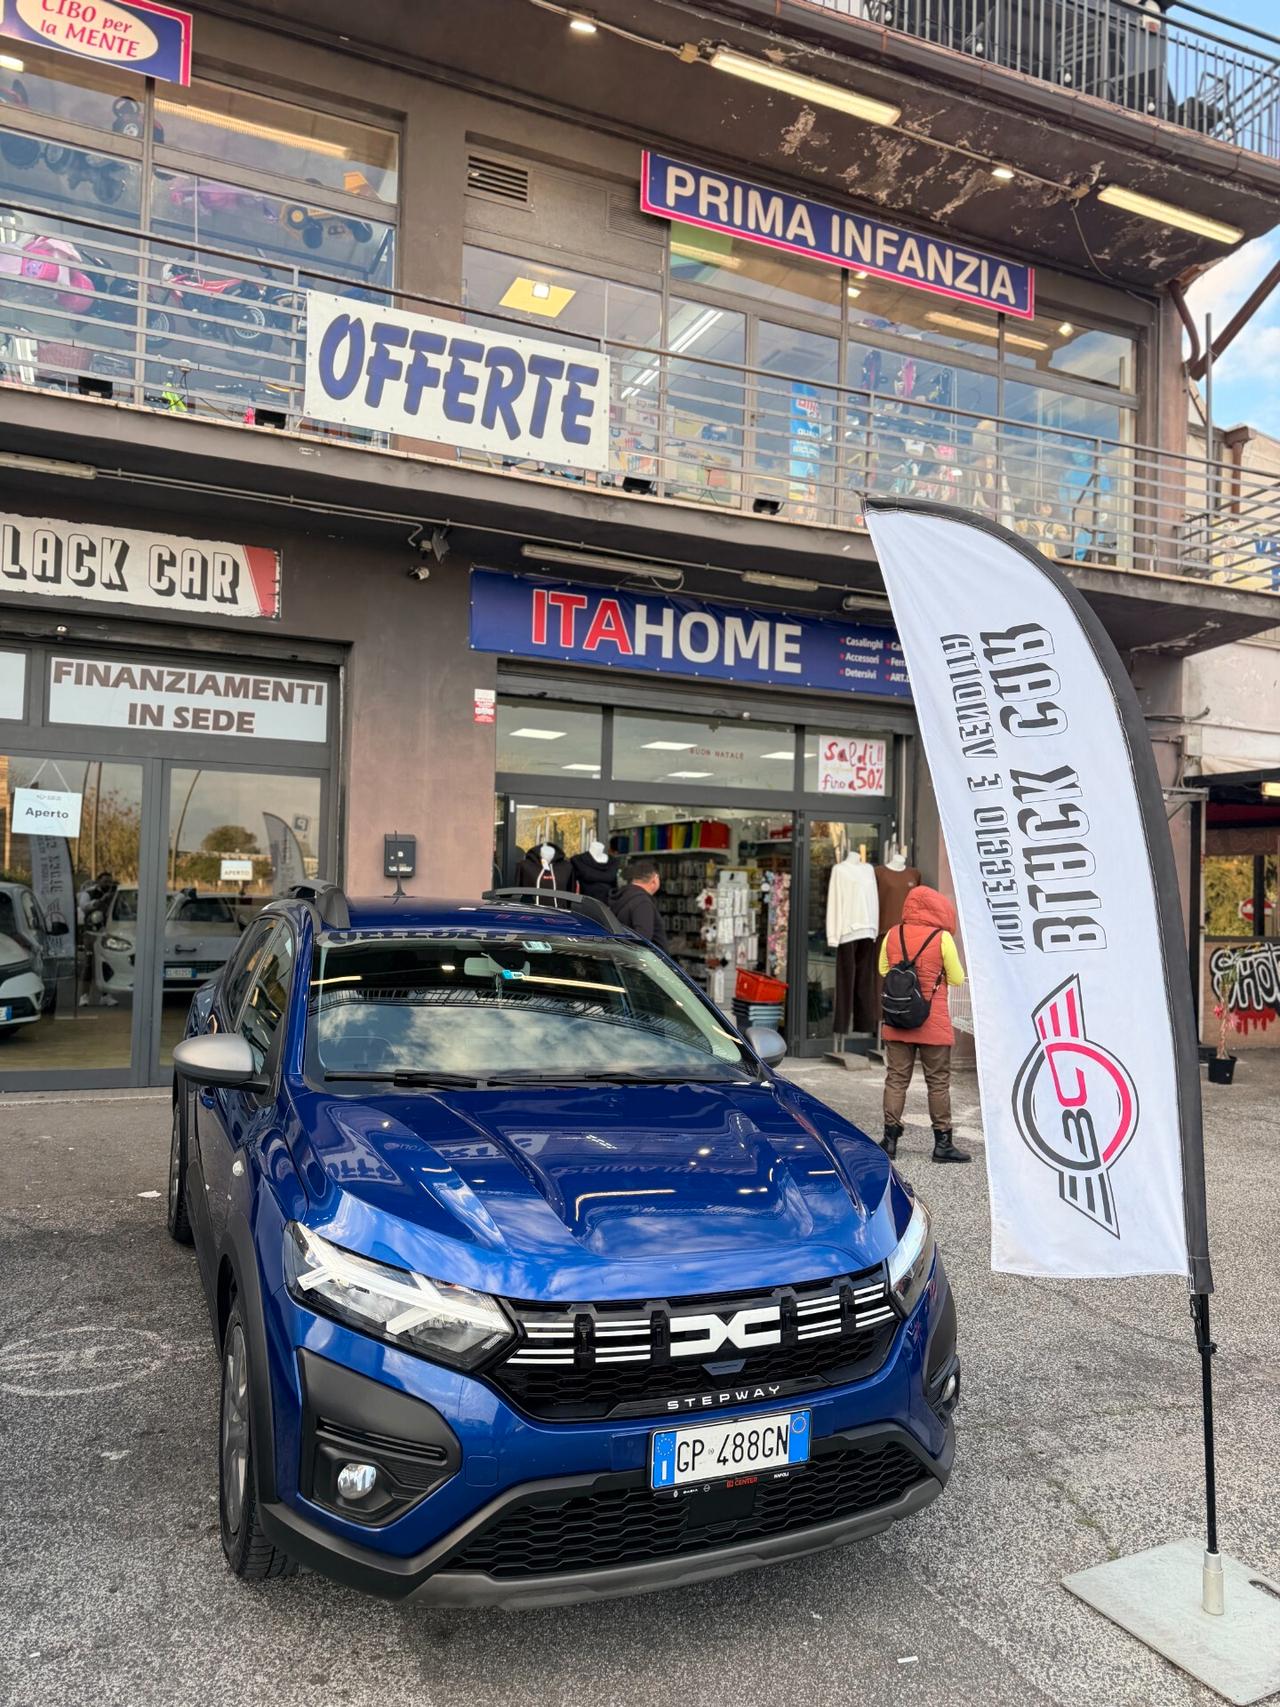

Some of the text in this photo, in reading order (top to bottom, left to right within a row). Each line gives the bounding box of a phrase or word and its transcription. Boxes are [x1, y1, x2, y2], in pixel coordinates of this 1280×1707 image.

[42, 0, 132, 33] CIBO per
[41, 20, 140, 58] la MENTE
[666, 166, 1016, 304] PRIMA INFANZIA
[318, 313, 600, 446] OFFERTE
[1, 524, 240, 604] LACK CAR
[532, 588, 802, 673] ITAHOME
[846, 637, 883, 650] Casalinghi
[845, 653, 879, 665] Accessori
[845, 668, 877, 679] Detersivi
[890, 657, 907, 667] Ferr
[53, 661, 323, 706] FINANZIAMENTI
[128, 702, 255, 733] IN SEDE
[25, 807, 69, 818] Aperto
[667, 1385, 780, 1410] STEPWAY
[676, 1424, 789, 1473] GP 488GN
